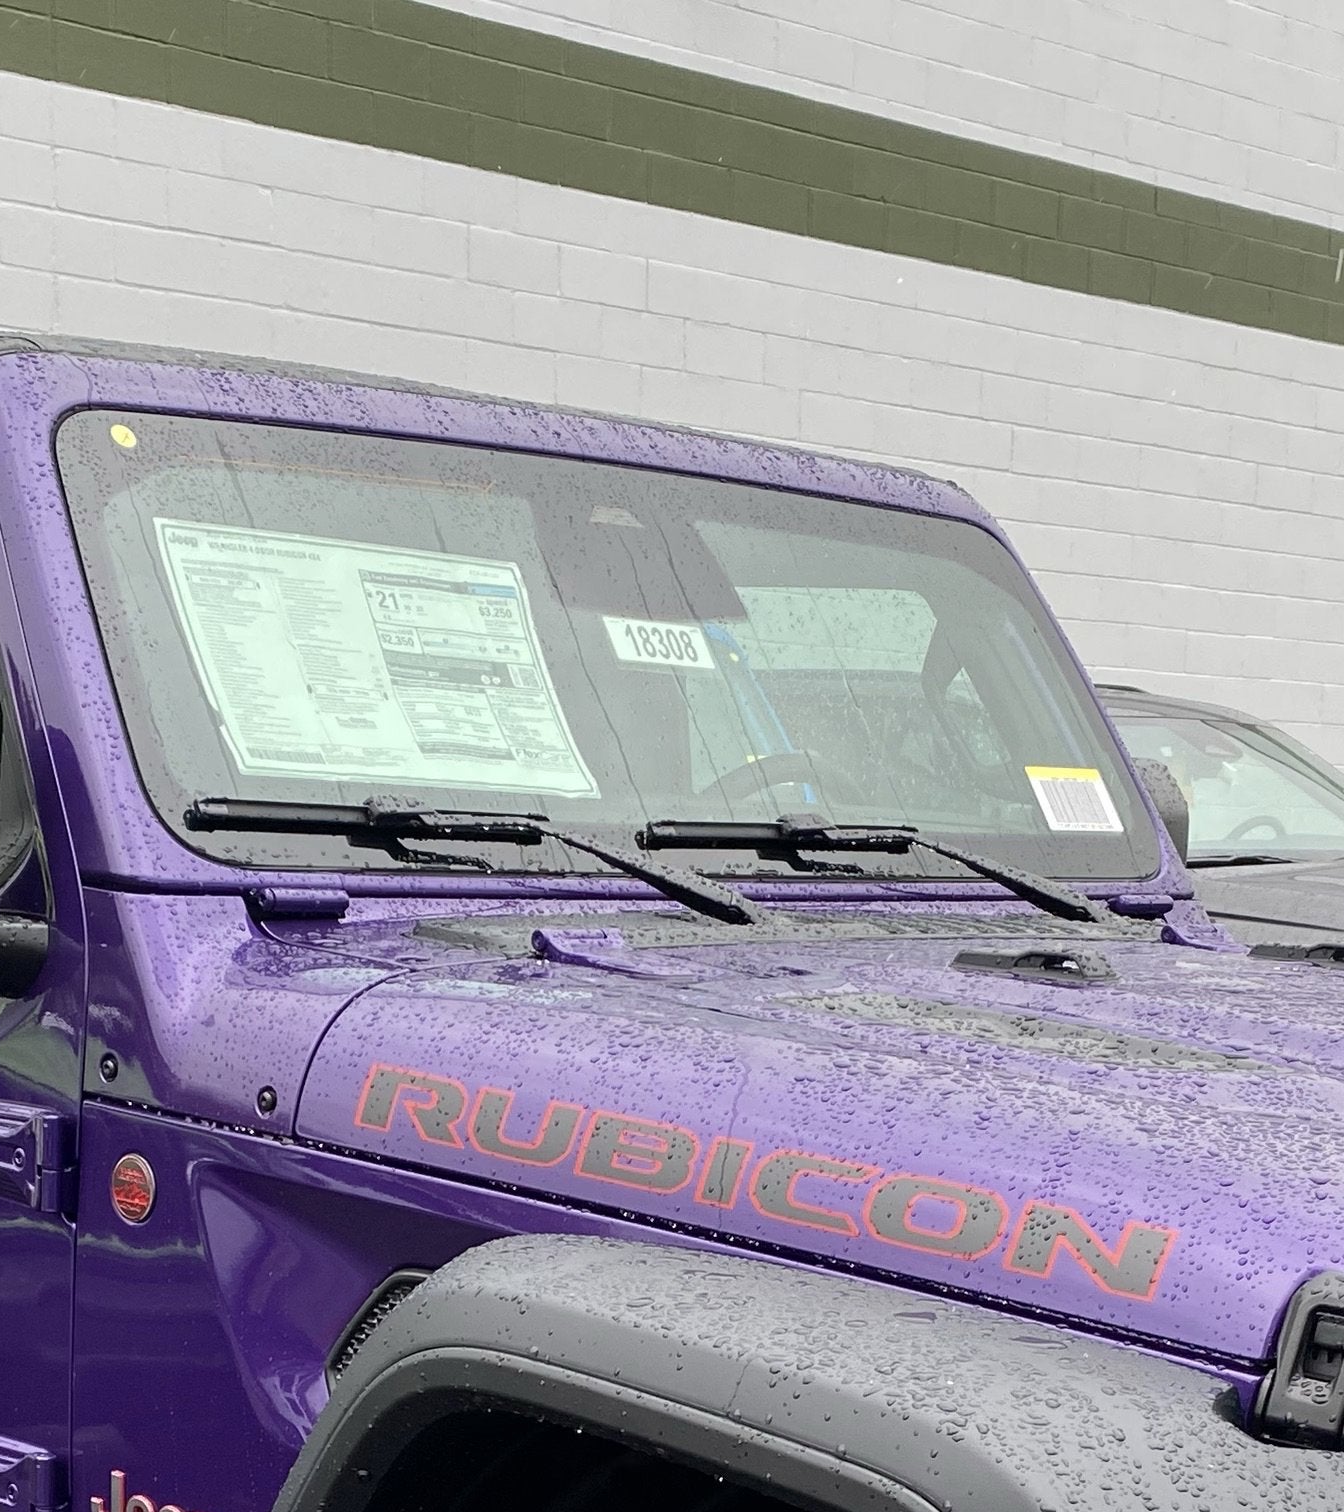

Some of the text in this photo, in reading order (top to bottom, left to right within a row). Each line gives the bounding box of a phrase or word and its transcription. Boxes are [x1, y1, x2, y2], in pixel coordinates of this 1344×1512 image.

[168, 531, 199, 548] Jeep
[375, 590, 399, 610] 21
[624, 623, 699, 663] 18308
[353, 1062, 1180, 1304] RUBICON
